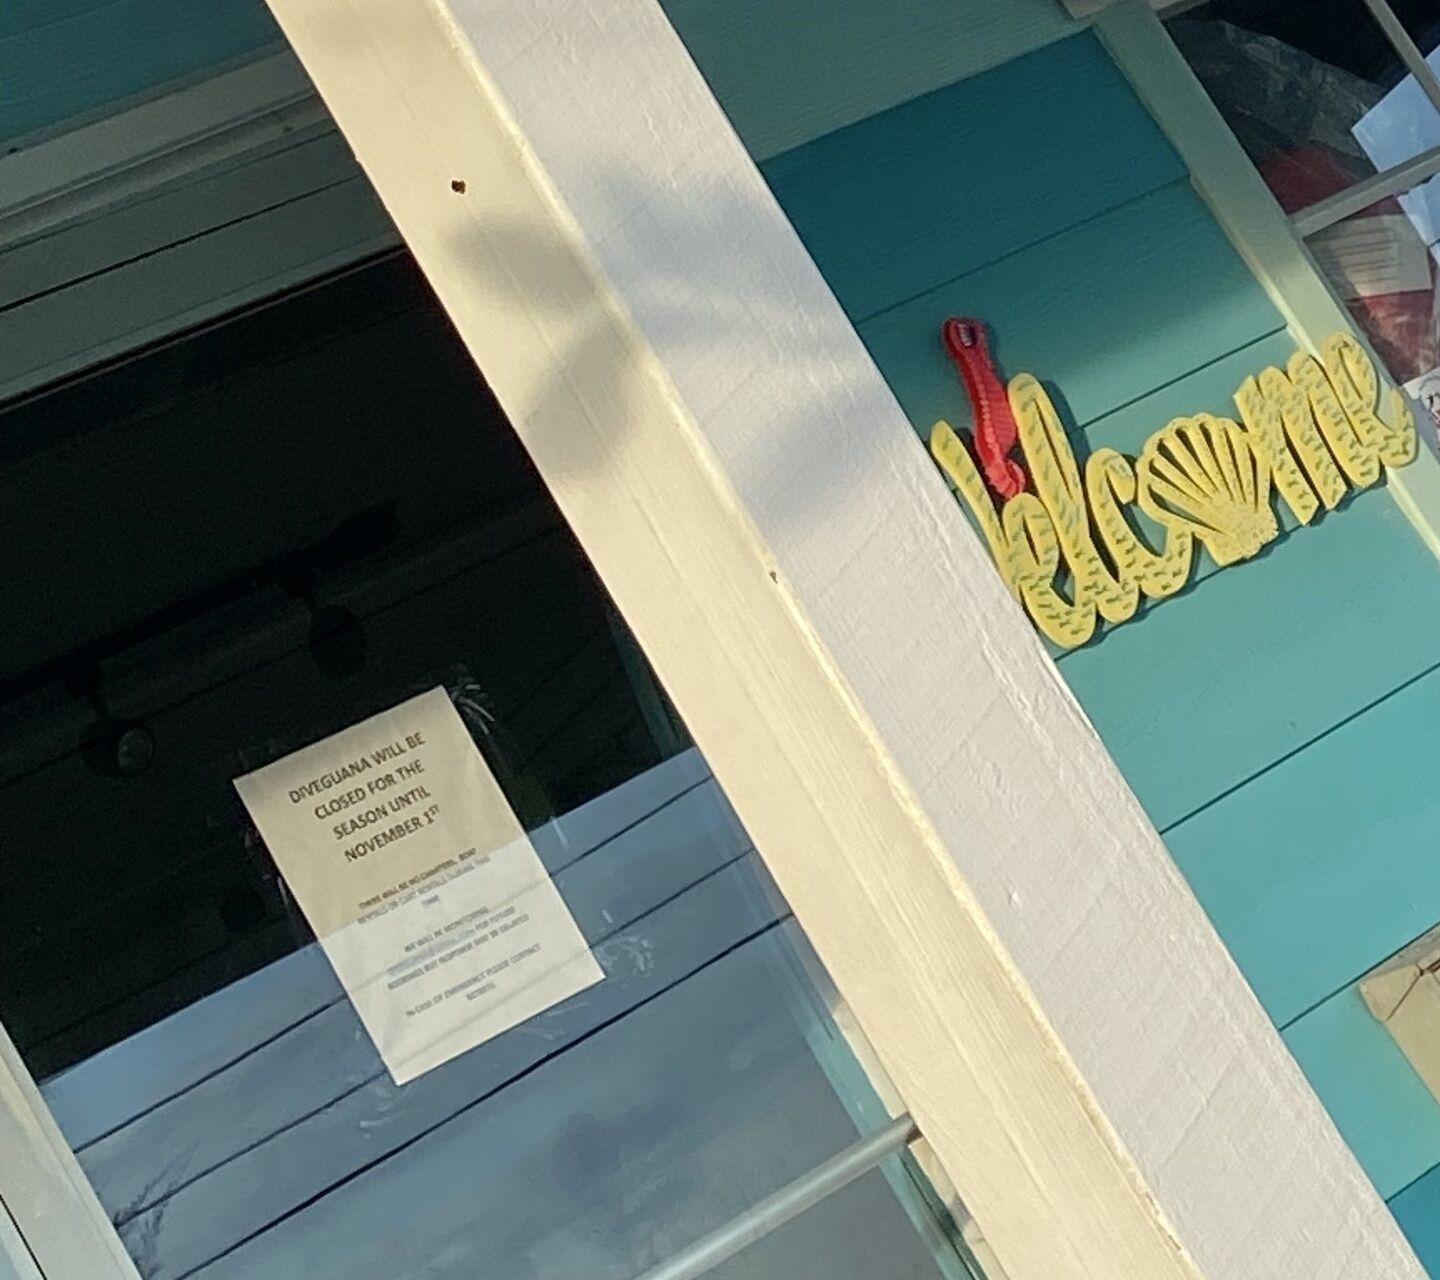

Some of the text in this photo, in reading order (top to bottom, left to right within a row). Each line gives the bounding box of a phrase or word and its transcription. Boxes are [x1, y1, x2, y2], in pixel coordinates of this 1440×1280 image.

[930, 332, 1416, 648] elcome
[289, 732, 426, 803] DIVEGUANA WILL BE
[314, 759, 425, 819] CLOSED FOR THE
[332, 785, 431, 840] SEASON UNTIL
[344, 817, 422, 863] NOVEMBER
